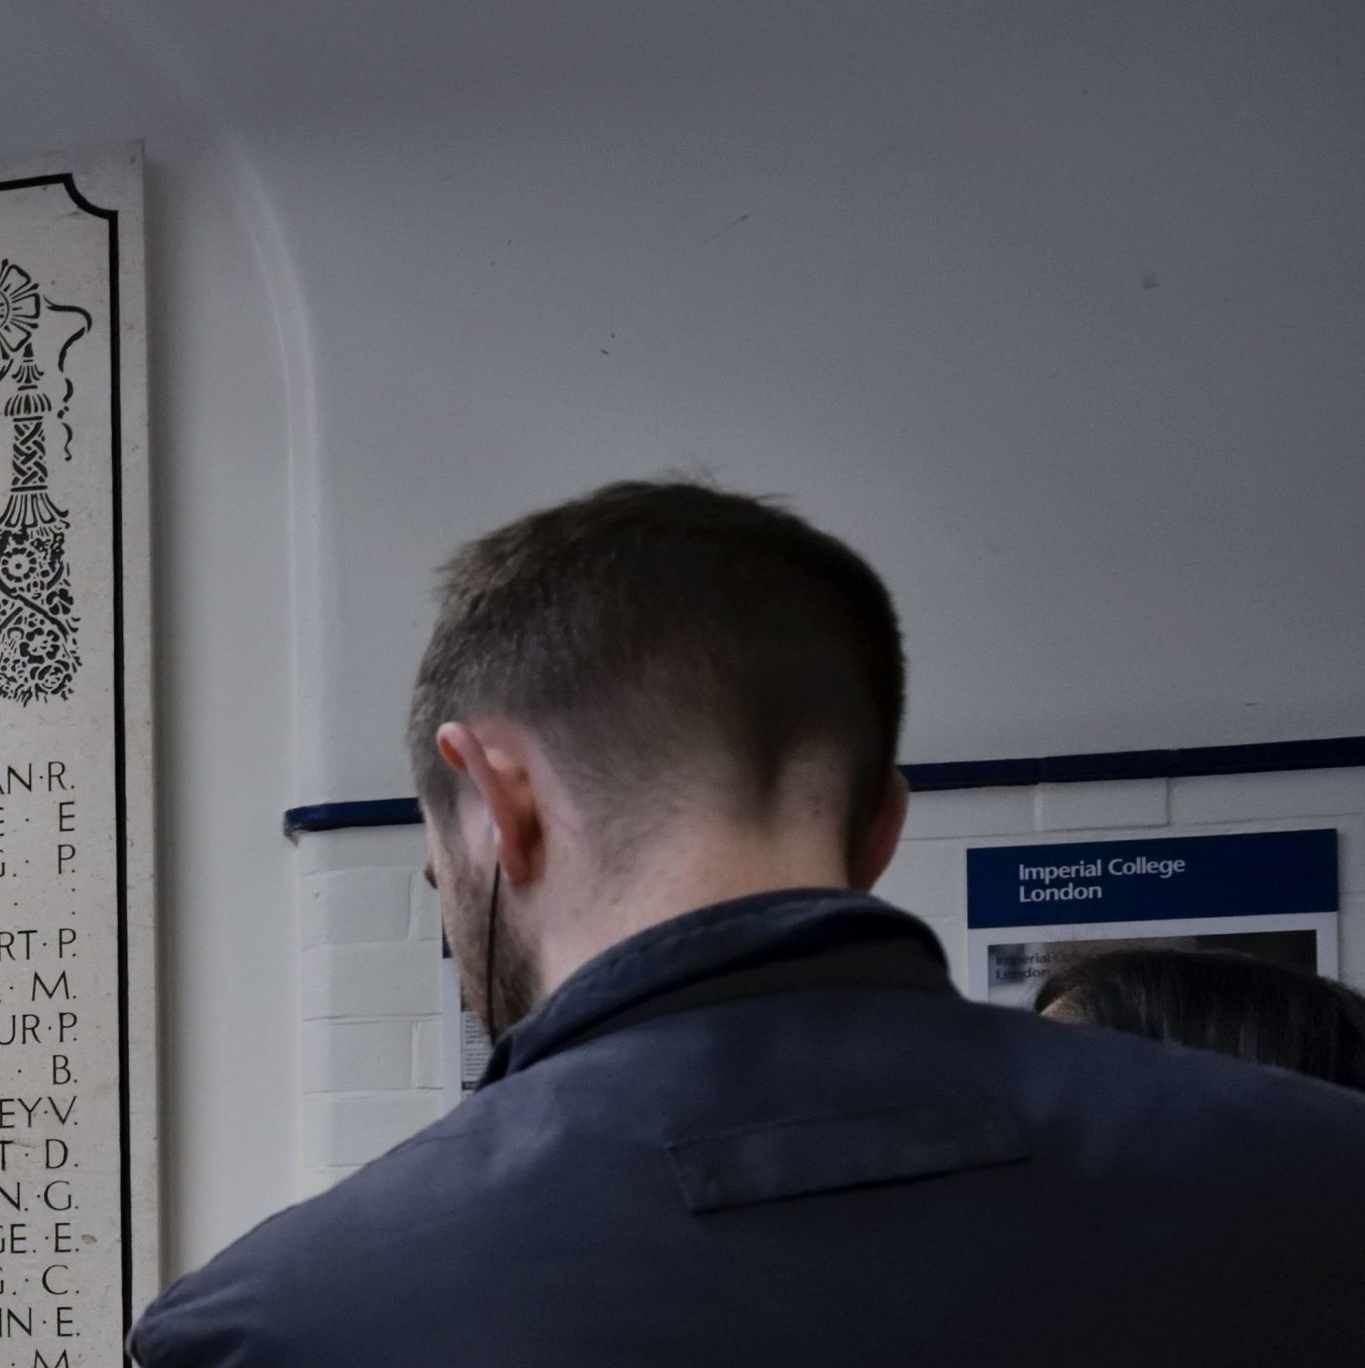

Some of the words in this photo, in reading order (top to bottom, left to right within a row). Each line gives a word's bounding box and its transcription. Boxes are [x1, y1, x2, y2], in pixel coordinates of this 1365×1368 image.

[1019, 859, 1102, 884] Imperial
[1108, 856, 1186, 879] College
[1020, 882, 1102, 902] London
